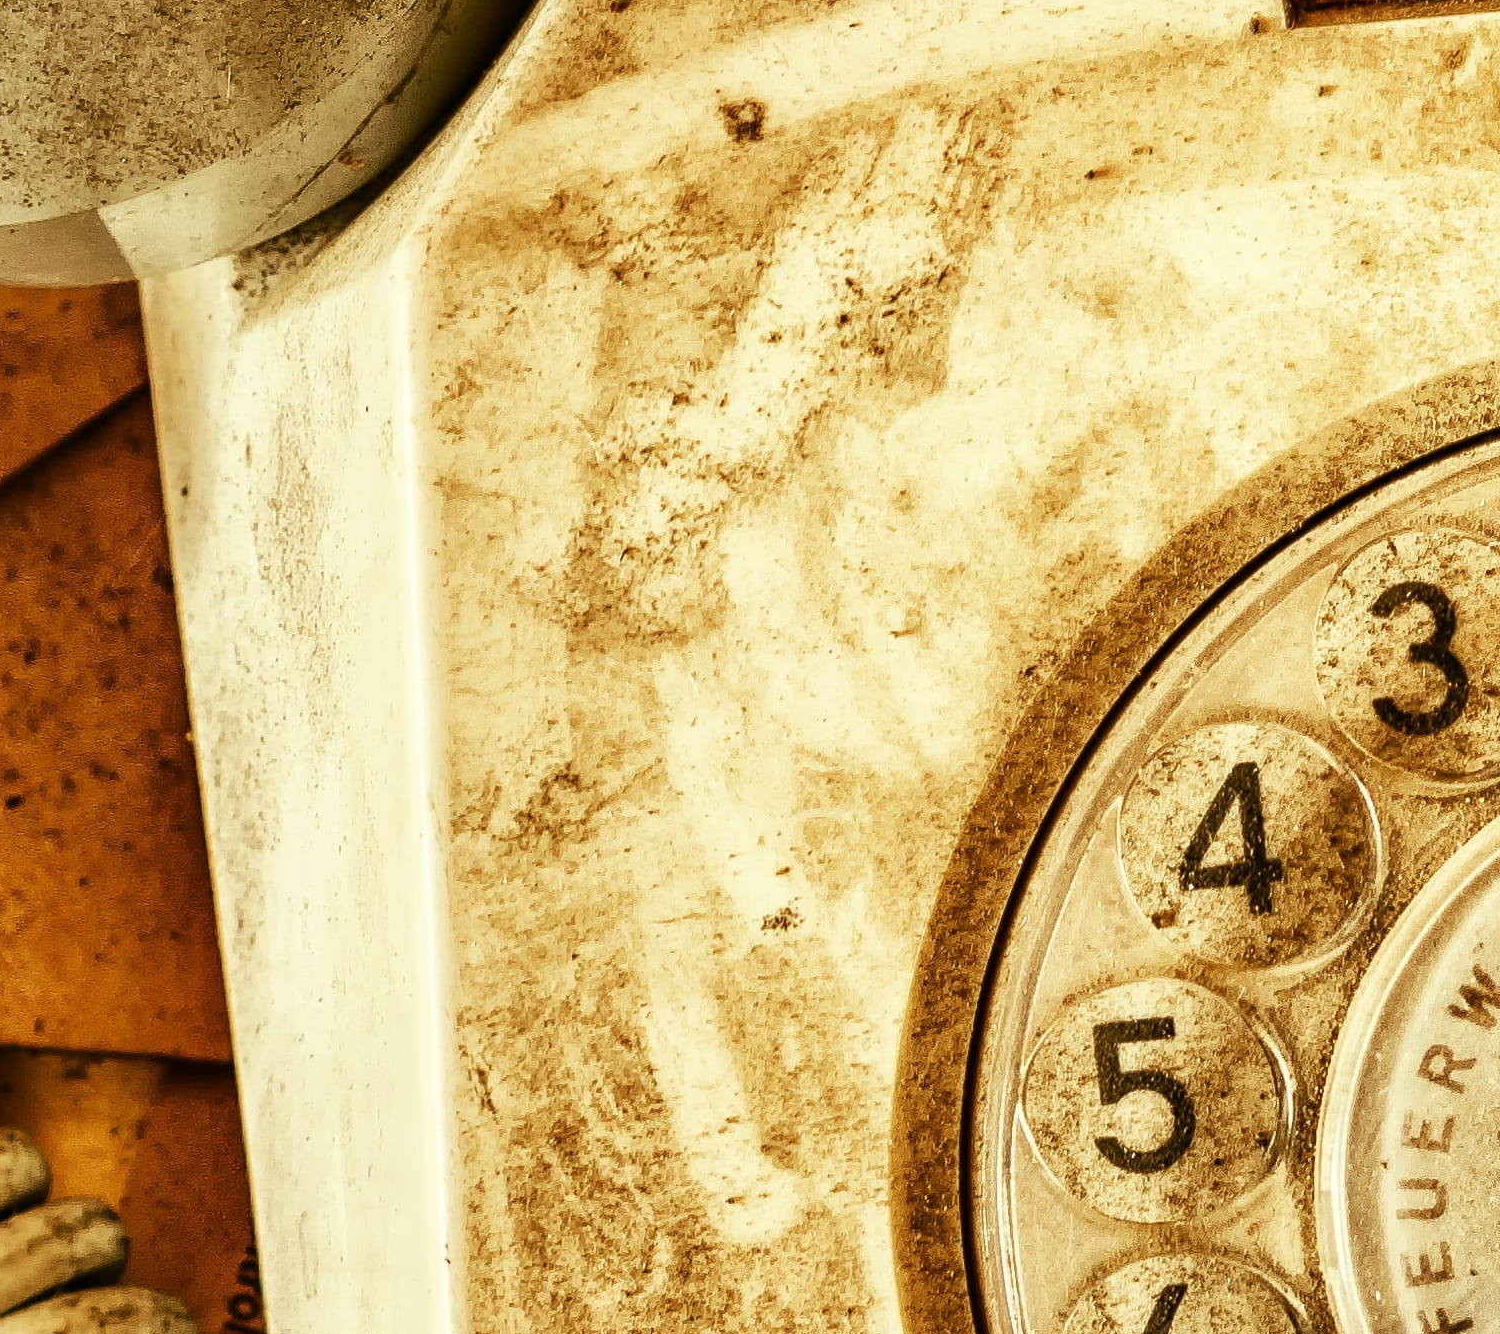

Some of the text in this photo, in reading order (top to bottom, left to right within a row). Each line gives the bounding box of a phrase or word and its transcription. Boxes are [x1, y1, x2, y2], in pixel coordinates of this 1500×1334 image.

[1369, 579, 1471, 736] 3
[1176, 760, 1284, 916] 4
[1093, 1016, 1198, 1176] 5
